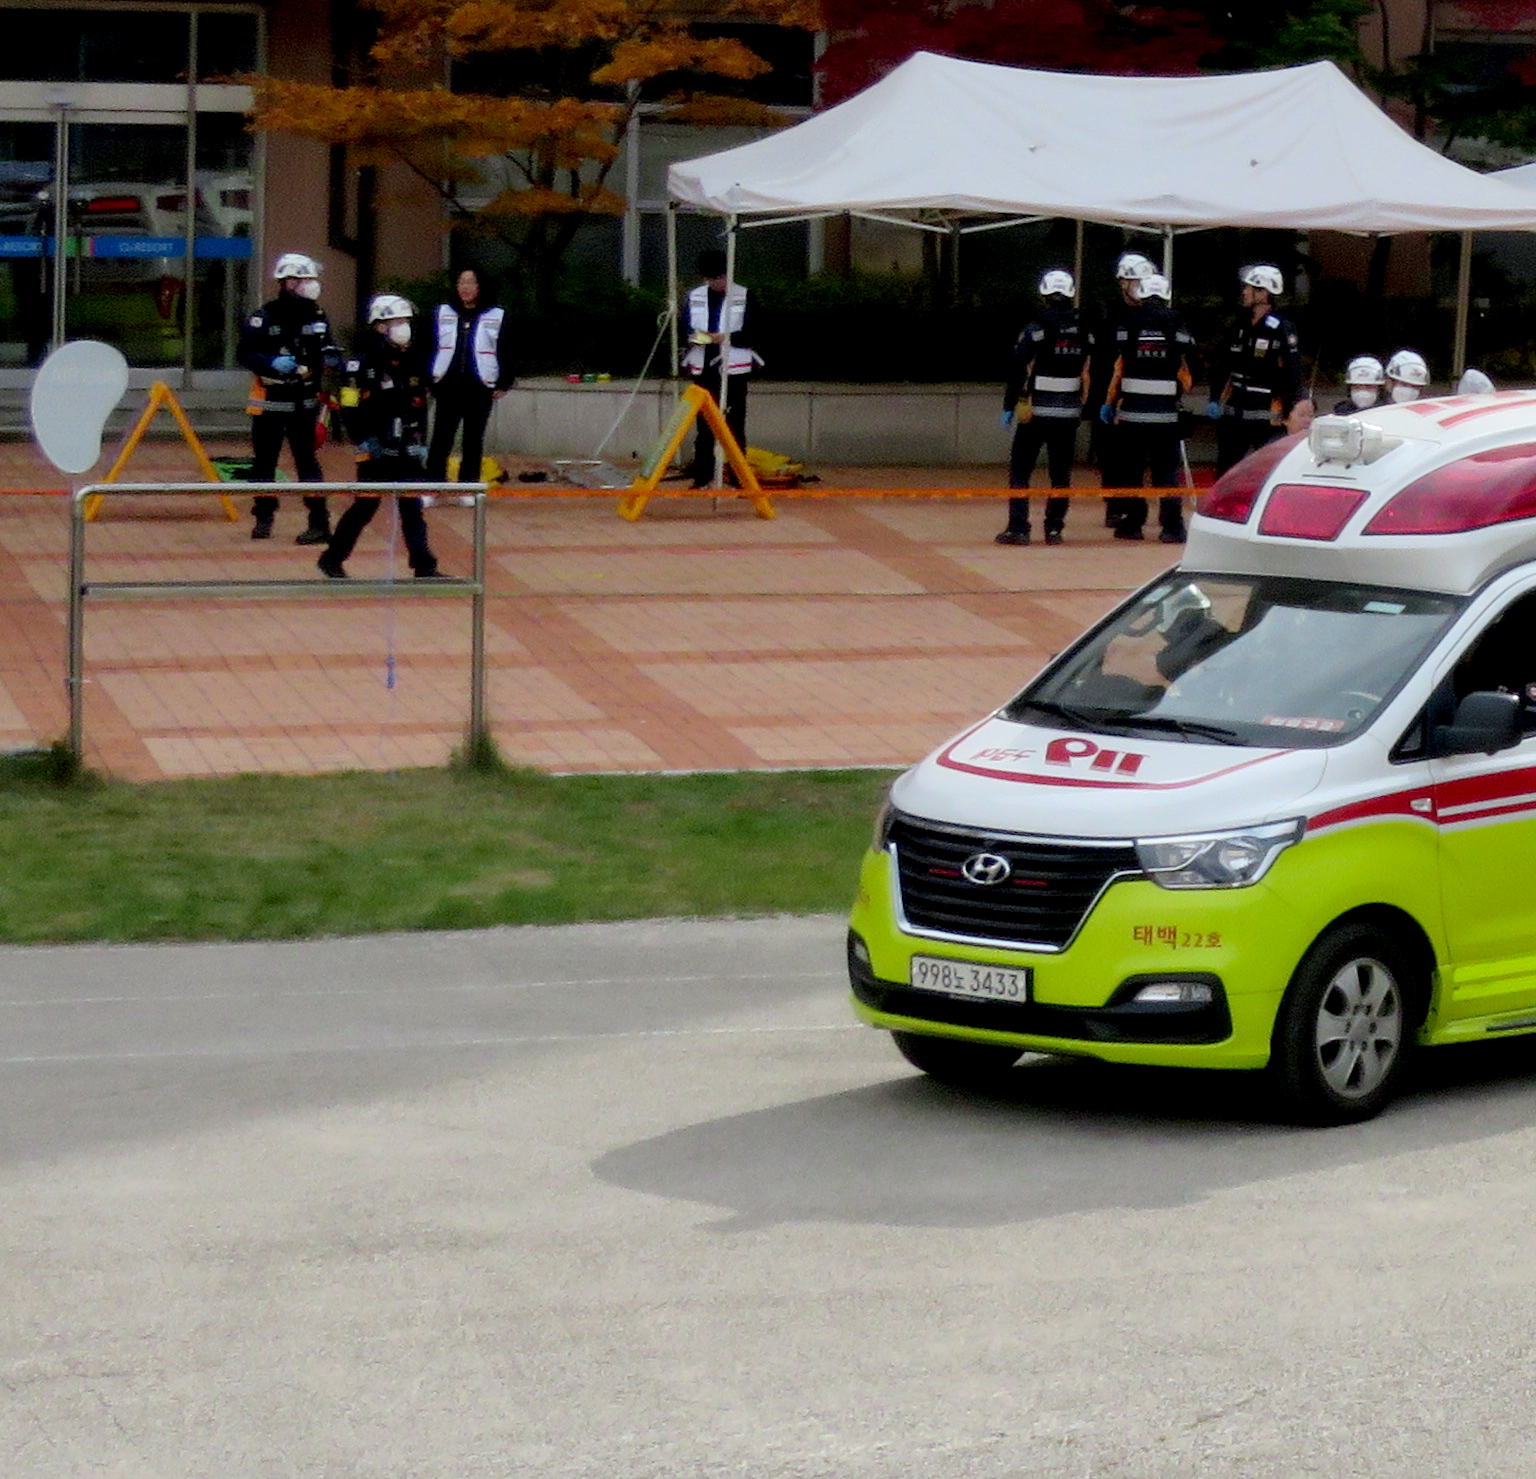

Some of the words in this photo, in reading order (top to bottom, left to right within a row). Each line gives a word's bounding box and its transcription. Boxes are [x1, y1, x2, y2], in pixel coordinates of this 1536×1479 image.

[1133, 925, 1178, 950] 태백
[1180, 931, 1222, 948] 22호
[918, 962, 964, 989] 998노
[970, 969, 1019, 997] 3433
